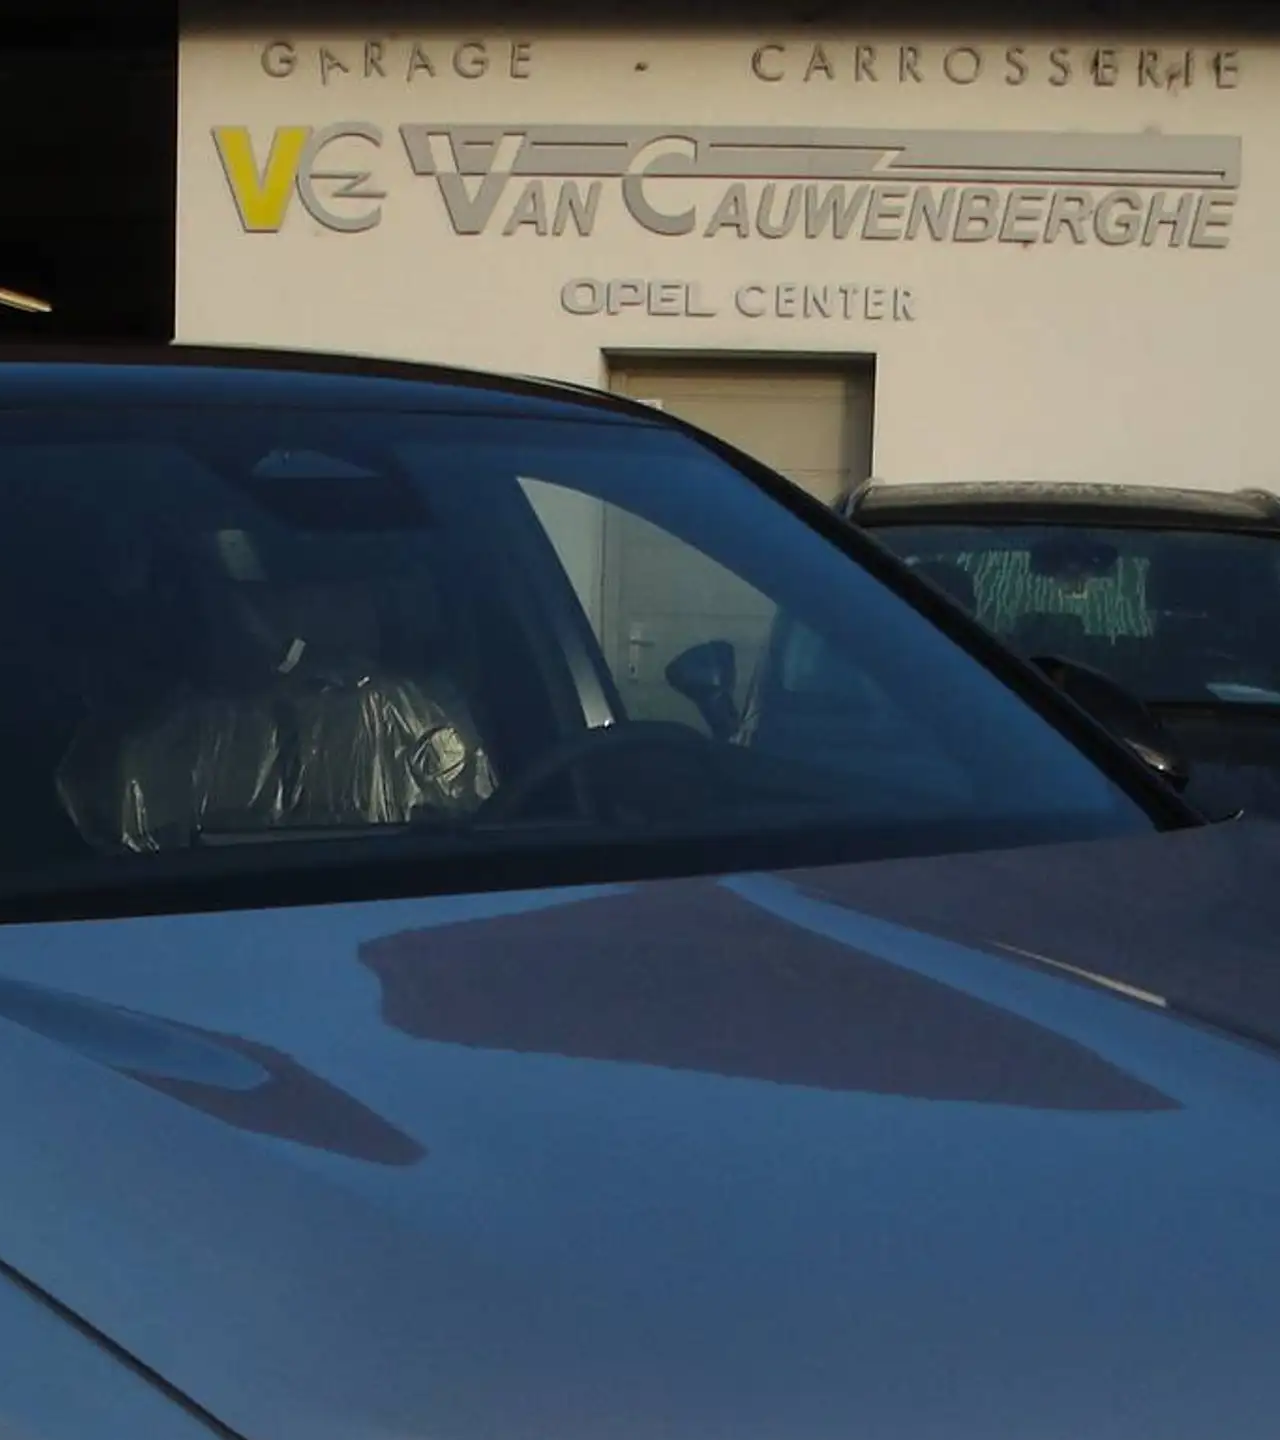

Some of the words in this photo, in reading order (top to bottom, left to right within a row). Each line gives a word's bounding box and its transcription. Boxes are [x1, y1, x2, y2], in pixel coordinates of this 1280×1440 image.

[261, 40, 532, 85] GARAGE
[751, 44, 1239, 90] CARROSSERIE
[425, 131, 603, 236] VAN
[622, 134, 1238, 248] CAUWENBERGHE
[560, 277, 718, 317] OPEL
[733, 282, 919, 322] CENTER
